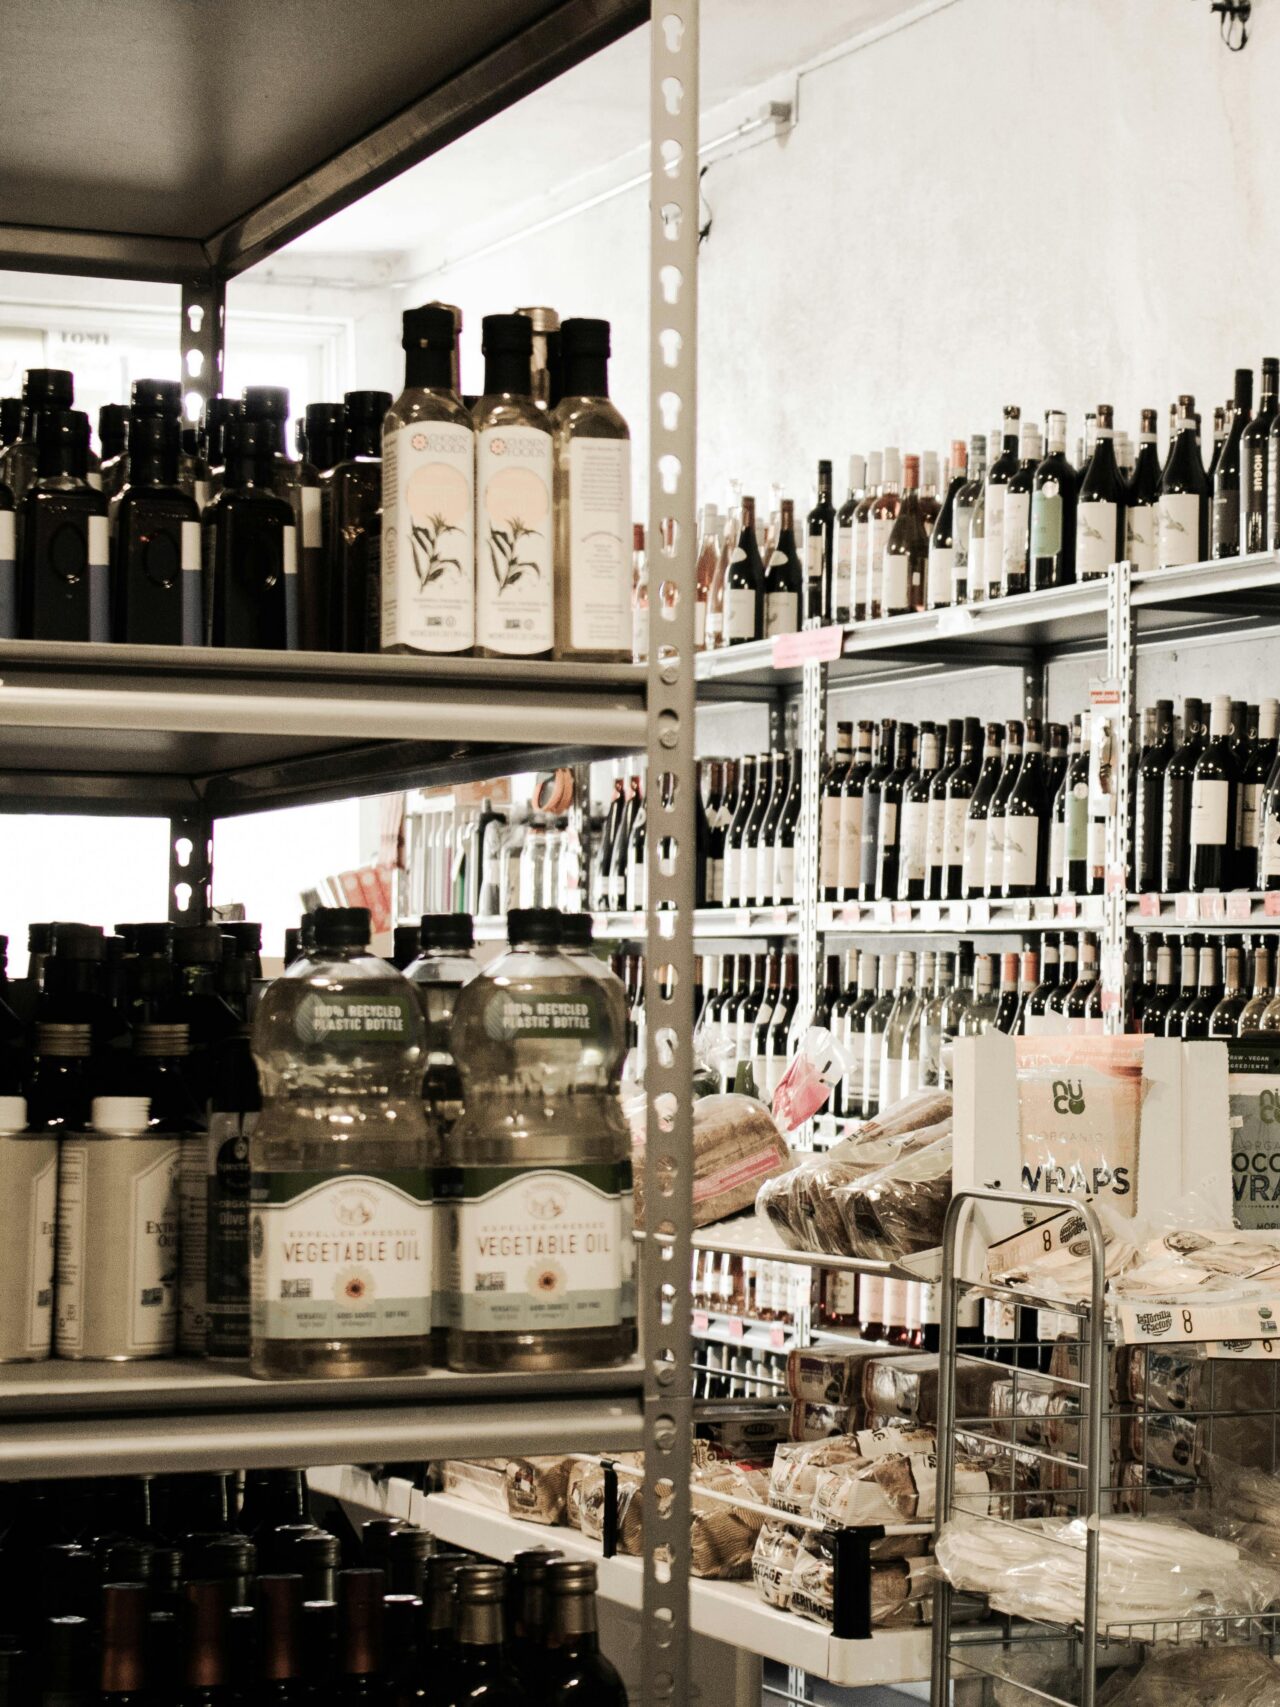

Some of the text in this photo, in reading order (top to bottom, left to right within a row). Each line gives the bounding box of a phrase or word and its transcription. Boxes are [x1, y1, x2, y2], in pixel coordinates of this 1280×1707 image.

[1254, 454, 1263, 492] HOGUE
[314, 1005, 402, 1018] 100% RECYCLED
[503, 1003, 589, 1017] 100% RECYCLED
[313, 1018, 404, 1031] PLASTIC BOTTLE
[503, 1016, 591, 1029] PLASTIC BOTTLE
[282, 1239, 421, 1264] VEGETABLE OIL
[476, 1232, 612, 1257] VEGETABLE OIL
[1042, 1229, 1052, 1252] 8
[1182, 1309, 1193, 1333] 8
